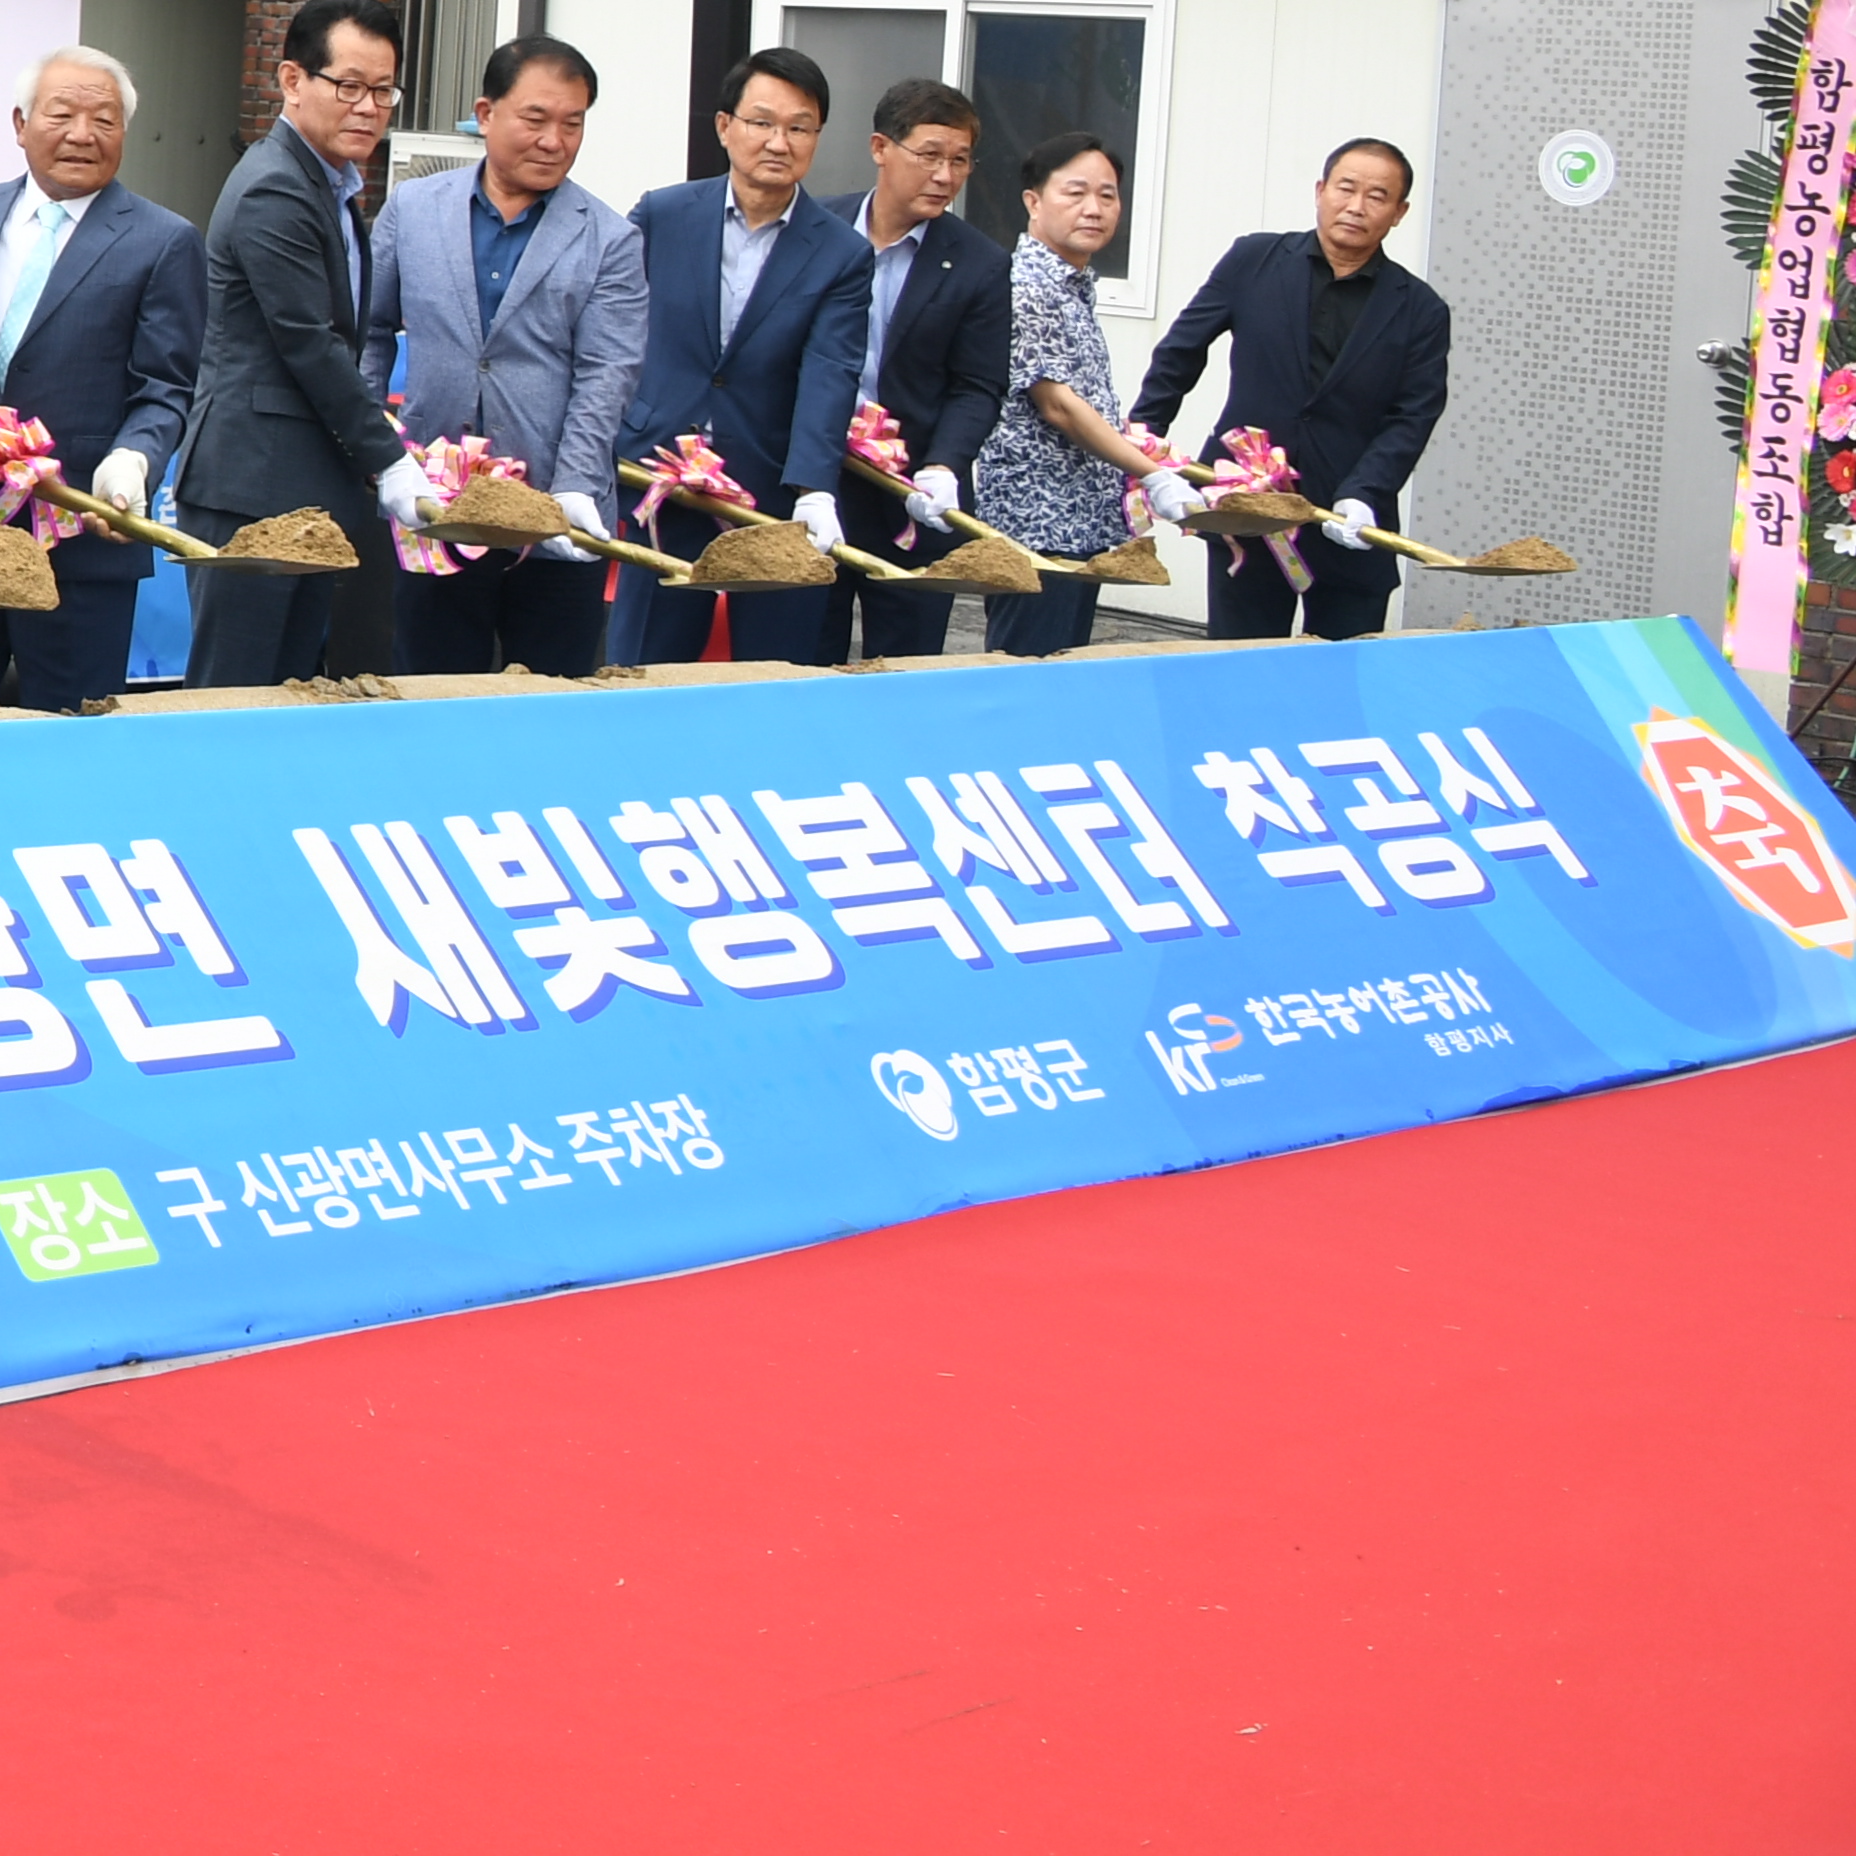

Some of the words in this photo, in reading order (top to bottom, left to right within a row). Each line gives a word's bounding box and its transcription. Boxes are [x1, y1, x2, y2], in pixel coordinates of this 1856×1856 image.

[1750, 58, 1853, 547] 함평농업협동조합
[291, 759, 1231, 1024] 새빛행복센터
[1191, 726, 1592, 910] 착공식
[1675, 765, 1822, 894] 축
[1244, 967, 1492, 1046] 한국농어촌공사
[1424, 1022, 1514, 1057] 함평지사
[947, 1039, 1105, 1117] 함평군
[156, 1166, 227, 1248] 구
[235, 1123, 573, 1236] 신광면사무소
[557, 1093, 725, 1186] 주차장
